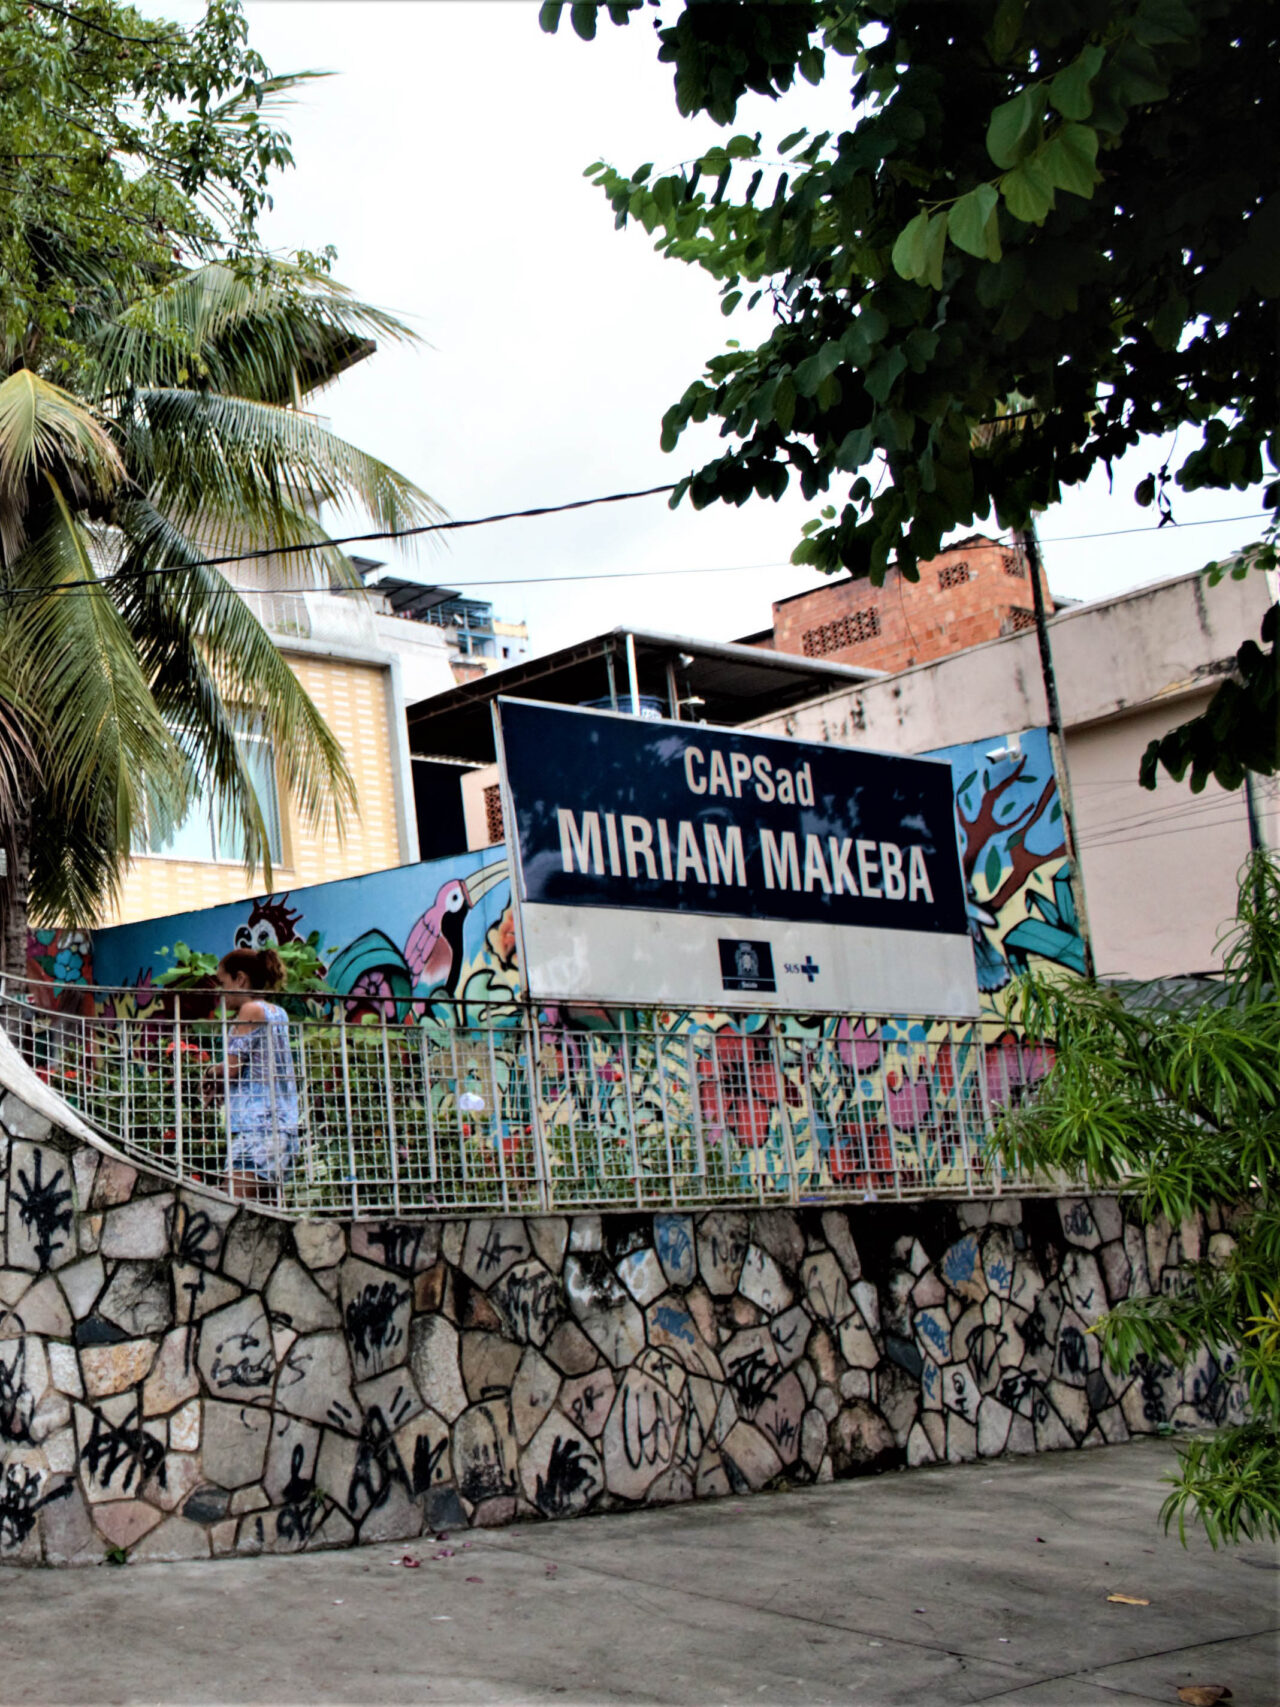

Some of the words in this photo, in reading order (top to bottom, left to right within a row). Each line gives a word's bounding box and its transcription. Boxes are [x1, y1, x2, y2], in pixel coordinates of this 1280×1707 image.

[684, 745, 815, 807] CAPSad
[557, 808, 748, 887] MIRIAM
[759, 829, 935, 903] MAKEBA
[783, 962, 800, 974] SUS
